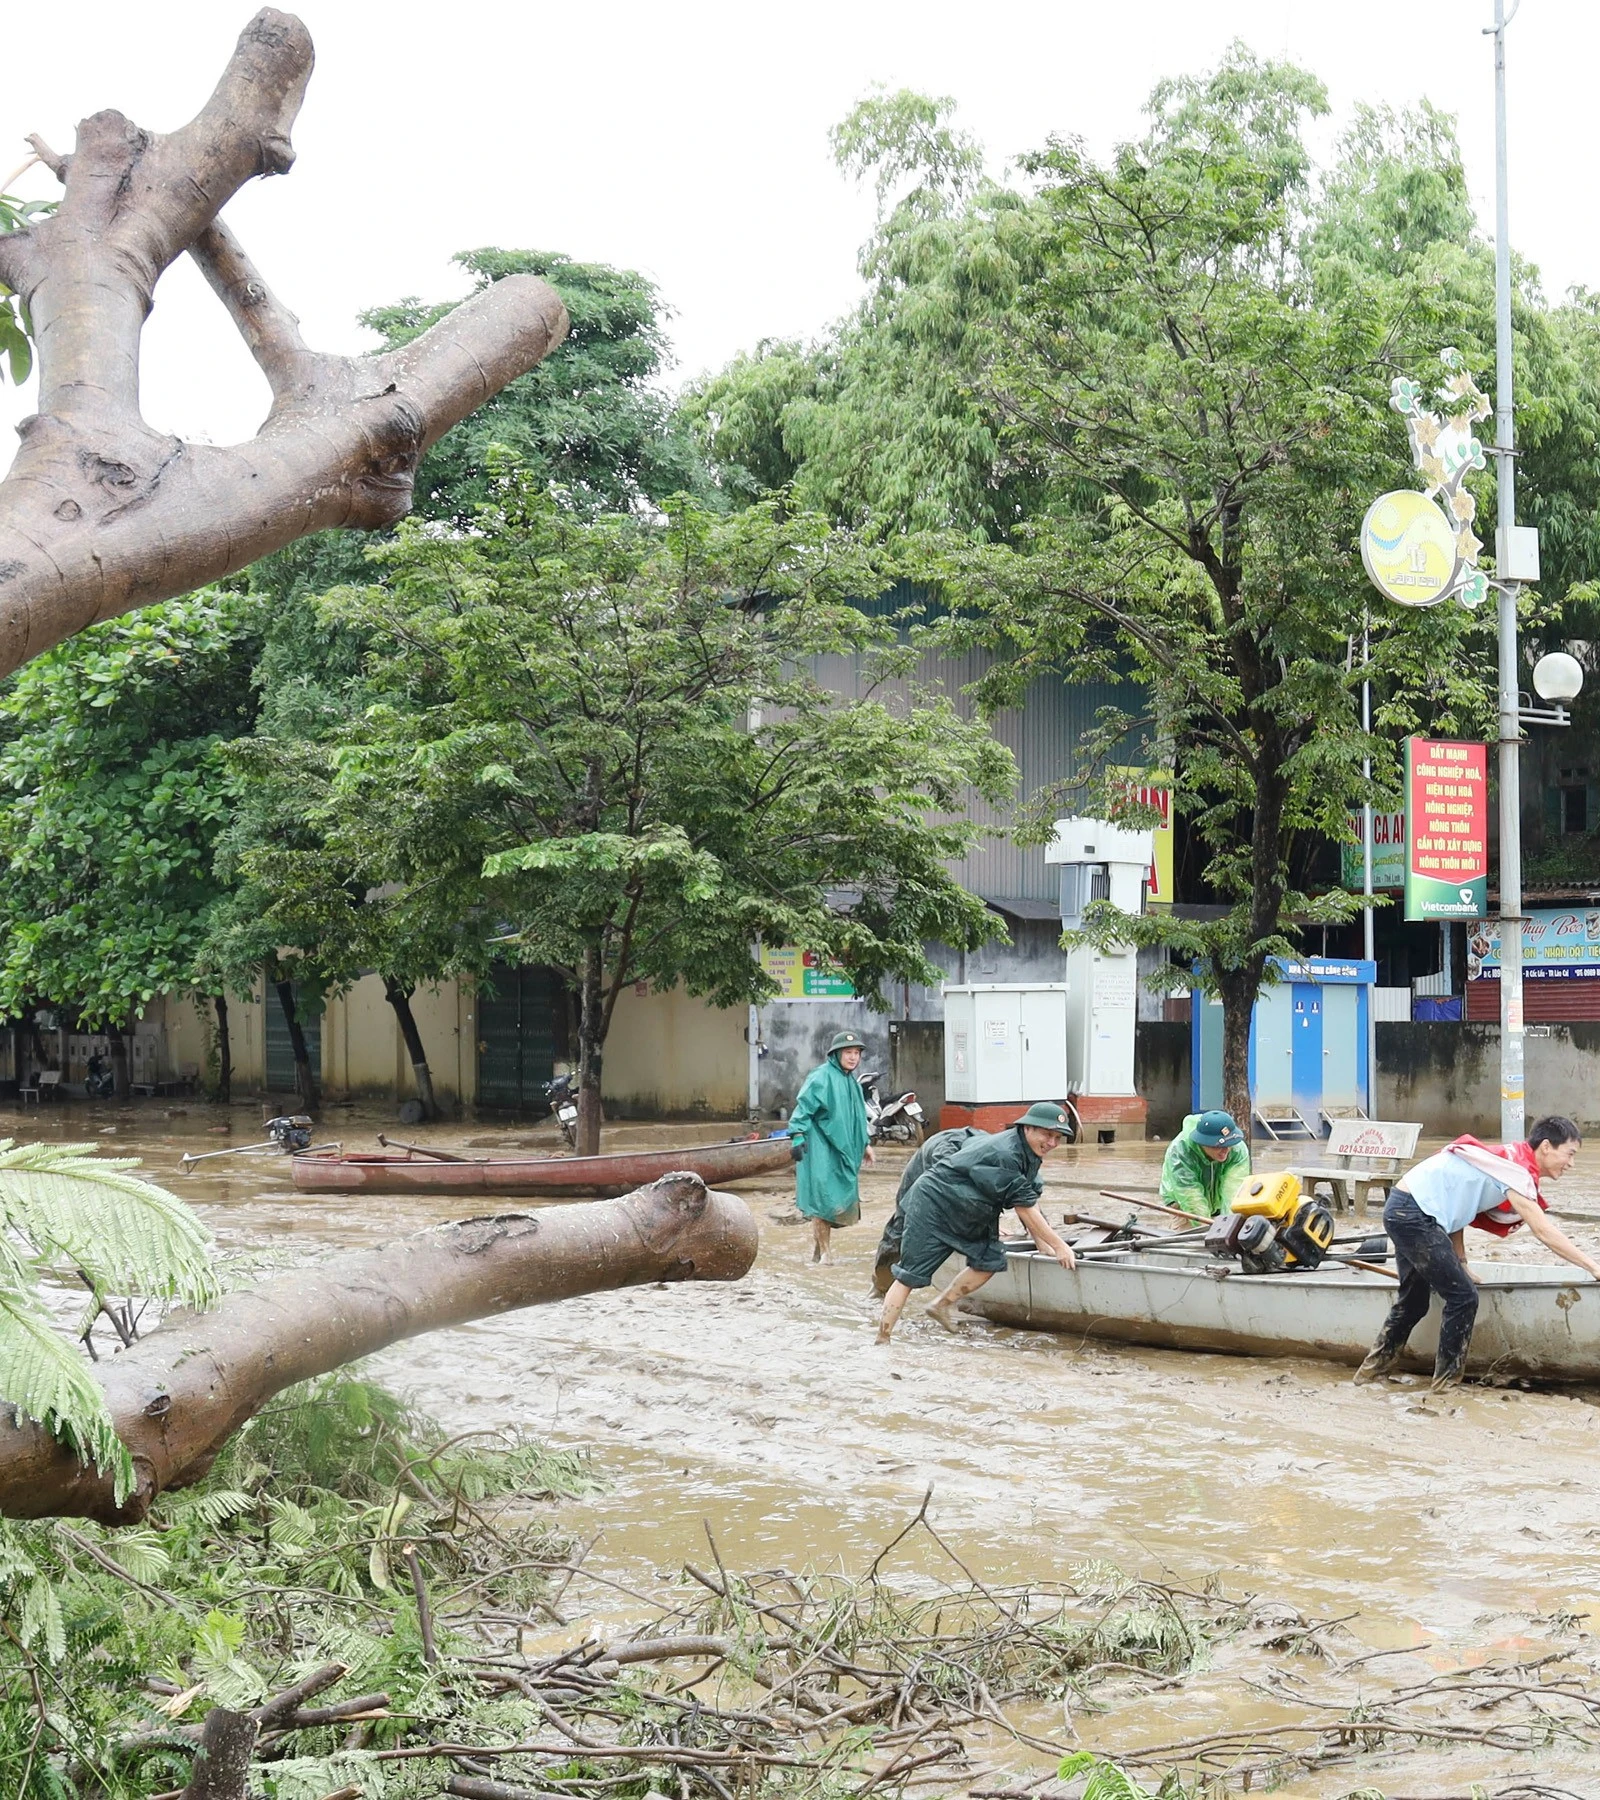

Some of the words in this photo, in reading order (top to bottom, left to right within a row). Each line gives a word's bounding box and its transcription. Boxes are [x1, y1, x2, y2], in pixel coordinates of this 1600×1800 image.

[1446, 748, 1468, 763] MẠNH
[1416, 763, 1436, 777] CÔNG
[1437, 765, 1464, 782] NGHIỆP
[1465, 766, 1482, 781] HOÁ,
[1426, 782, 1443, 797] HIỆN
[1444, 785, 1457, 799] ĐẠI
[1458, 784, 1473, 798] HOÁ
[1425, 800, 1446, 815] NÔNG
[1447, 802, 1474, 818] NGHIỆP,
[1429, 819, 1450, 833] NÔNG
[1451, 820, 1470, 834] THÔN
[1417, 834, 1432, 850] GẮN
[1433, 837, 1446, 851] VỚI
[1462, 840, 1482, 854] DỰNG
[1419, 855, 1440, 869] NÔNG
[1441, 856, 1460, 870] THÔN
[1461, 857, 1475, 870] MỚI
[1421, 901, 1478, 912] Vietcombank
[1551, 914, 1585, 936] Béo
[1543, 944, 1566, 961] NHẬN
[1338, 1144, 1397, 1156] 02143.820.820
